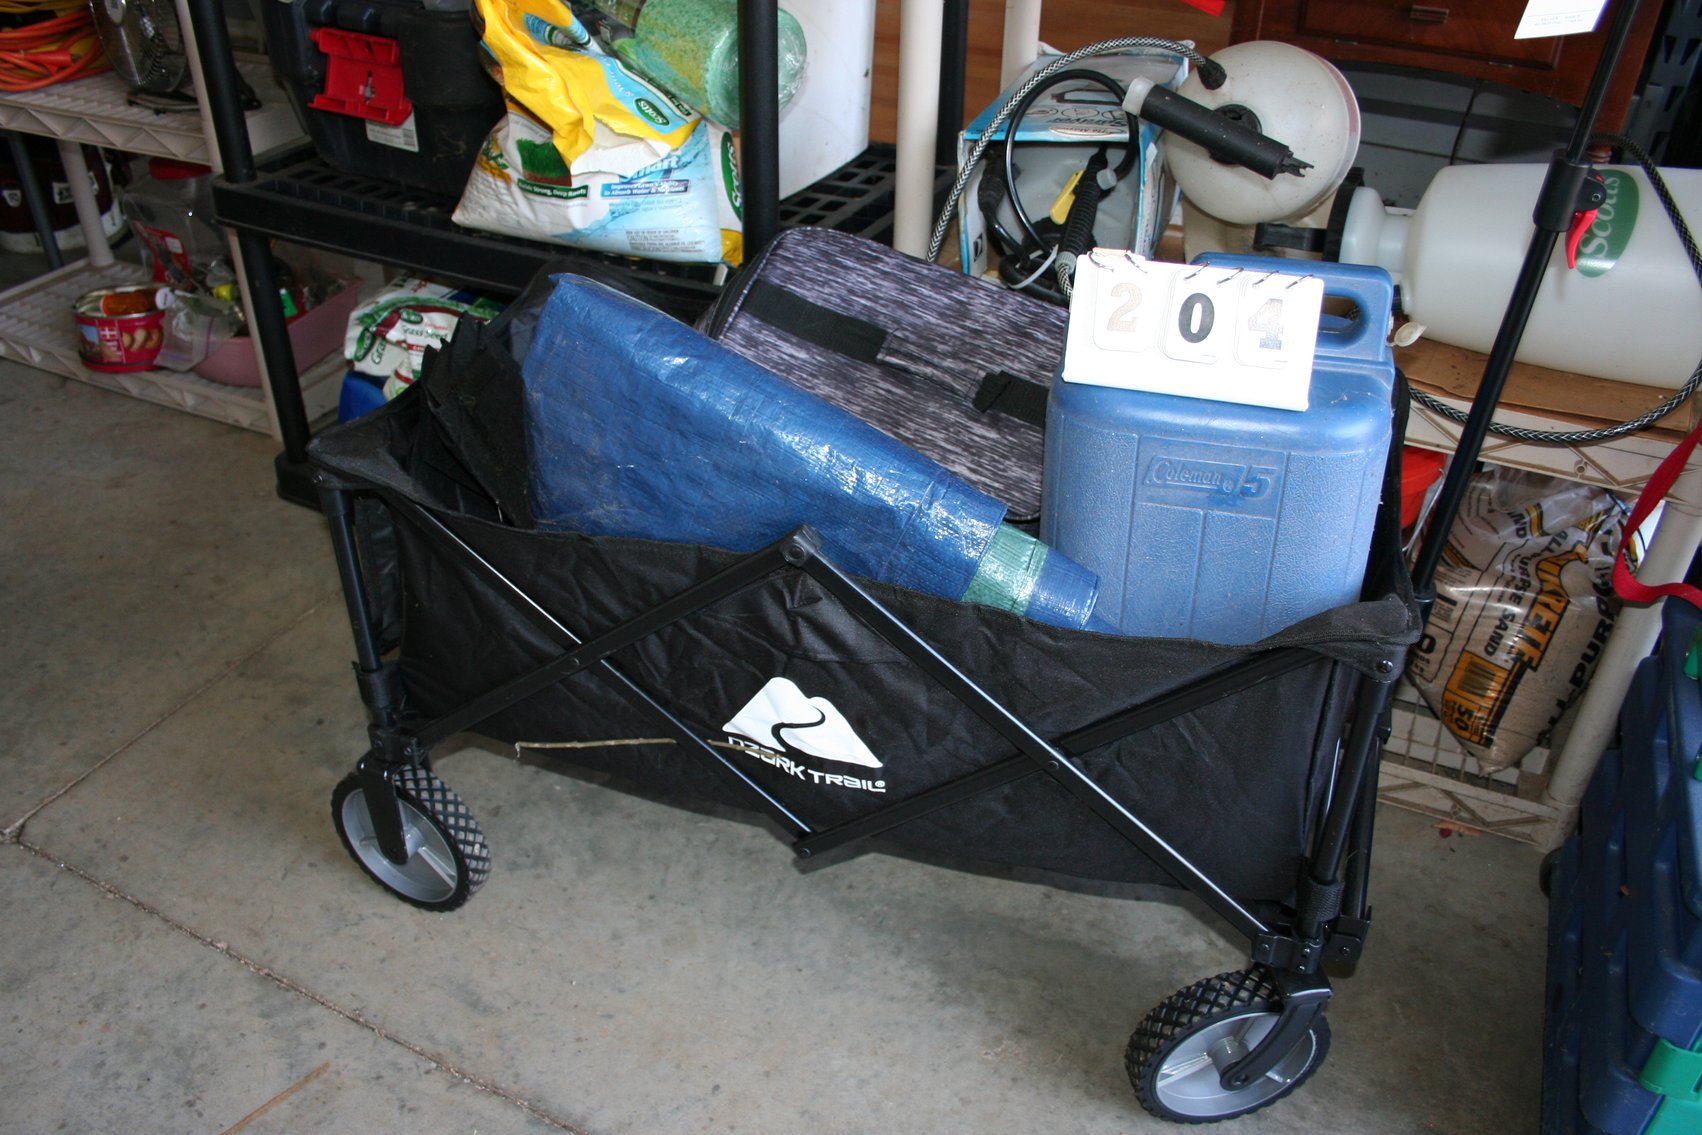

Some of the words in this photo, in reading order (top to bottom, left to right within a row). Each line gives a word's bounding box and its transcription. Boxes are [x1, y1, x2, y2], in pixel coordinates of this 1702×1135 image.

[1152, 460, 1222, 486] Coleman
[1484, 607, 1517, 658] SAND
[1455, 703, 1474, 732] 50
